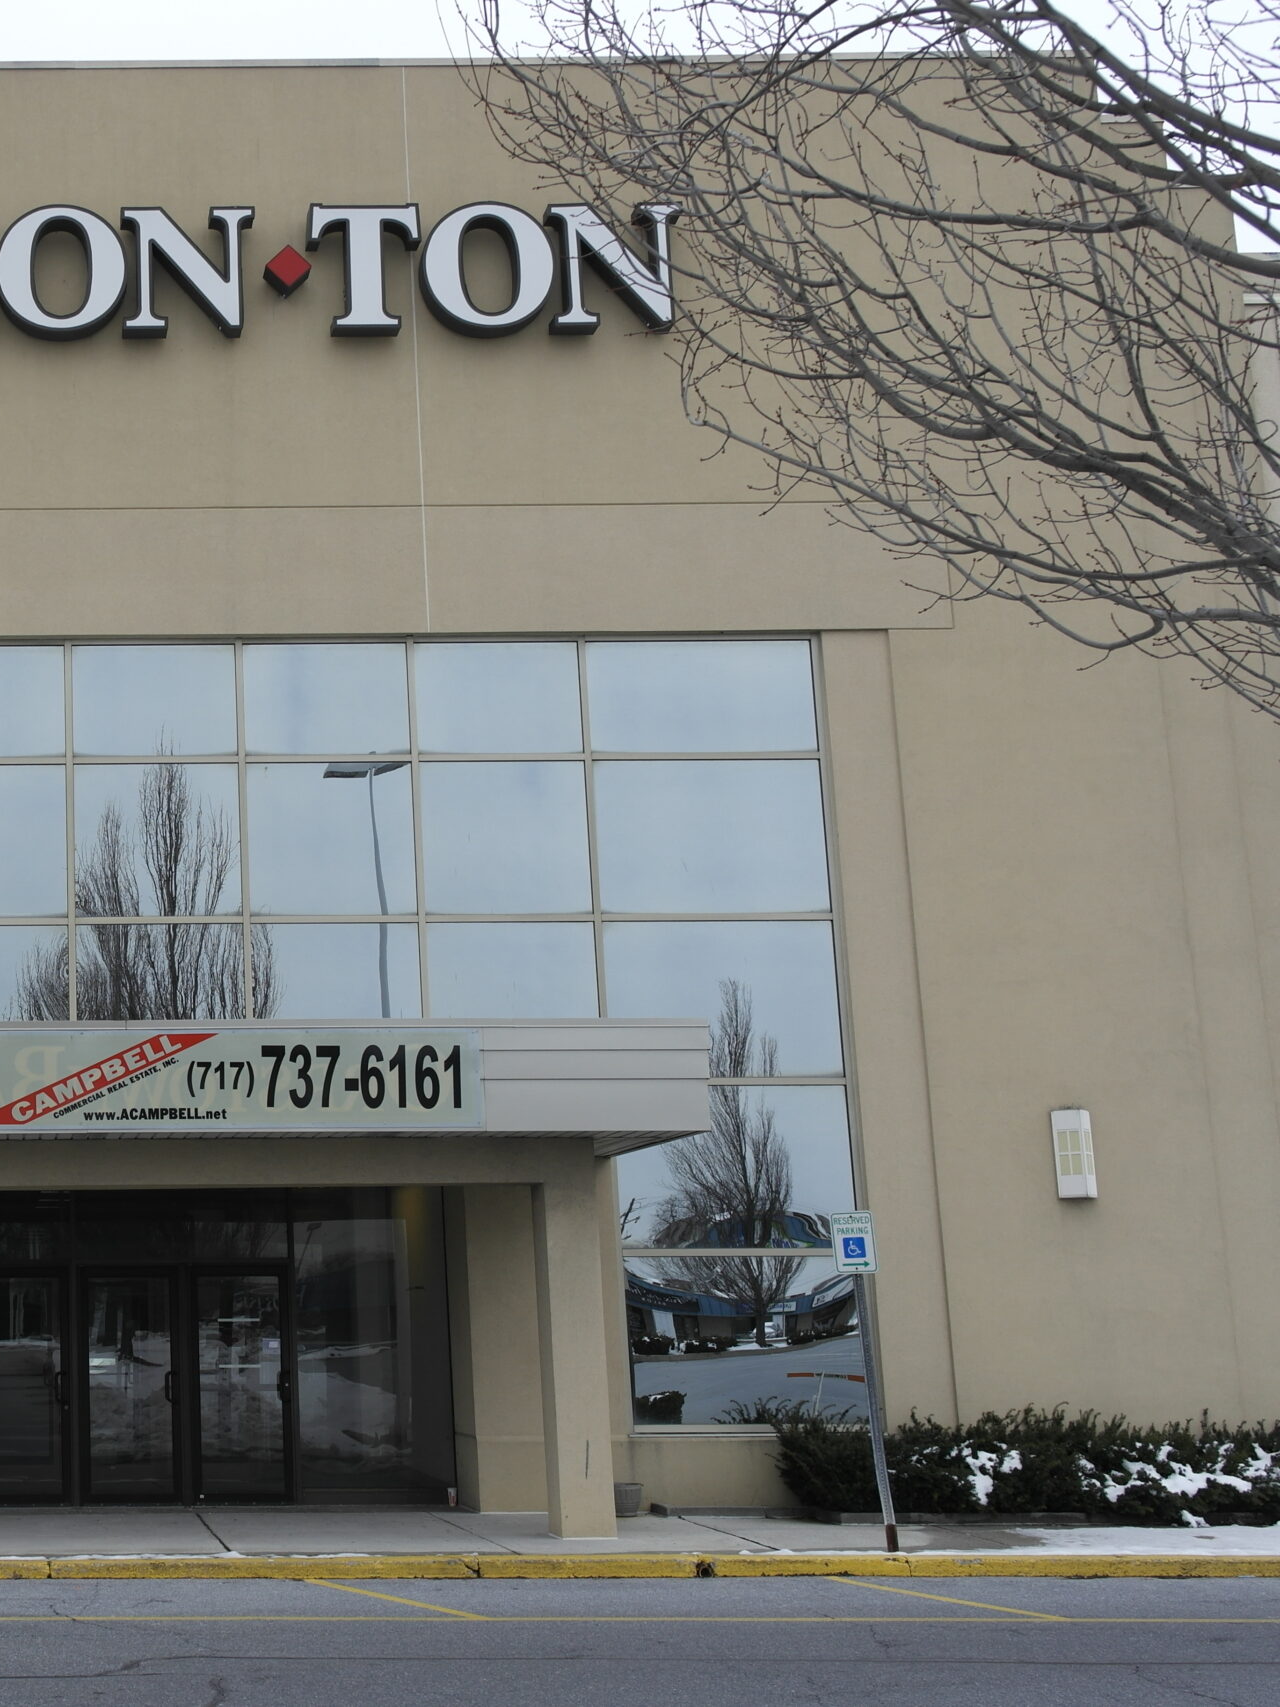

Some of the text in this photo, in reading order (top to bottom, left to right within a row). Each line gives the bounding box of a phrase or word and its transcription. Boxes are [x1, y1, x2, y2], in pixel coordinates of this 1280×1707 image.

[10, 1034, 183, 1123] CAMPBELL
[53, 1057, 180, 1119] COMMERCIAL REAL ESTATE, INC.
[186, 1043, 462, 1109] (717) 737-6161
[83, 1107, 228, 1122] www.ACAMPBELL.net
[832, 1216, 870, 1225] RESERVED
[836, 1226, 869, 1235] PARKING
